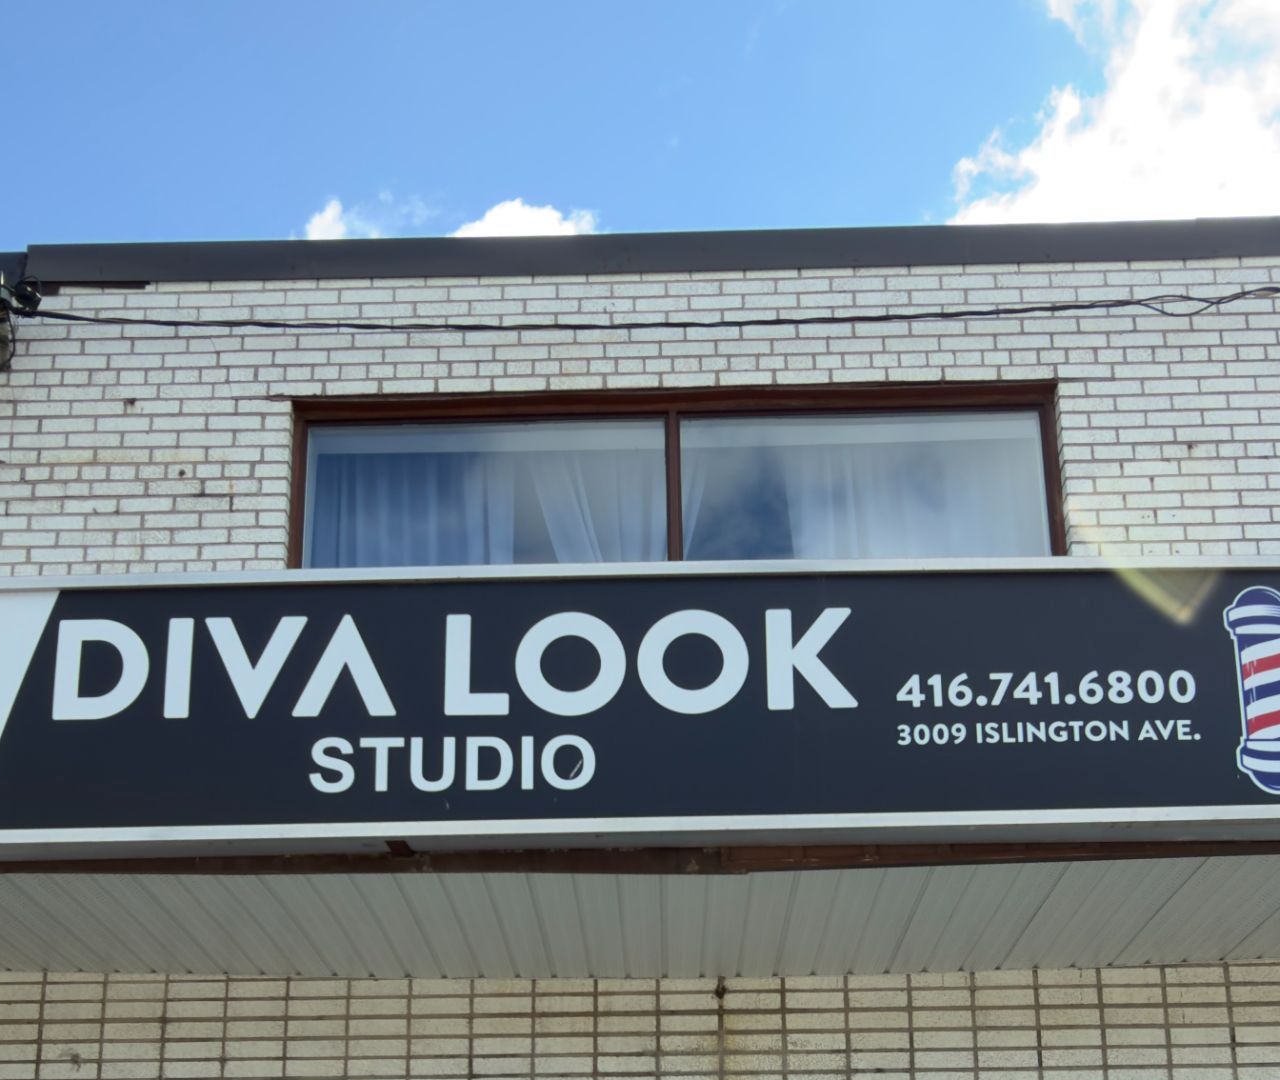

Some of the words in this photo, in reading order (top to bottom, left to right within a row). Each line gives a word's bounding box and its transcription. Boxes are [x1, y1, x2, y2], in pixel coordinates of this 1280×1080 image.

[51, 613, 397, 721] DIVA
[443, 607, 859, 718] LOOK
[896, 668, 1197, 710] 416.741.6800
[896, 722, 968, 747] 3009
[975, 720, 1133, 745] ISLINGTON
[1137, 718, 1202, 743] AVE.
[309, 734, 597, 794] STUDIO
